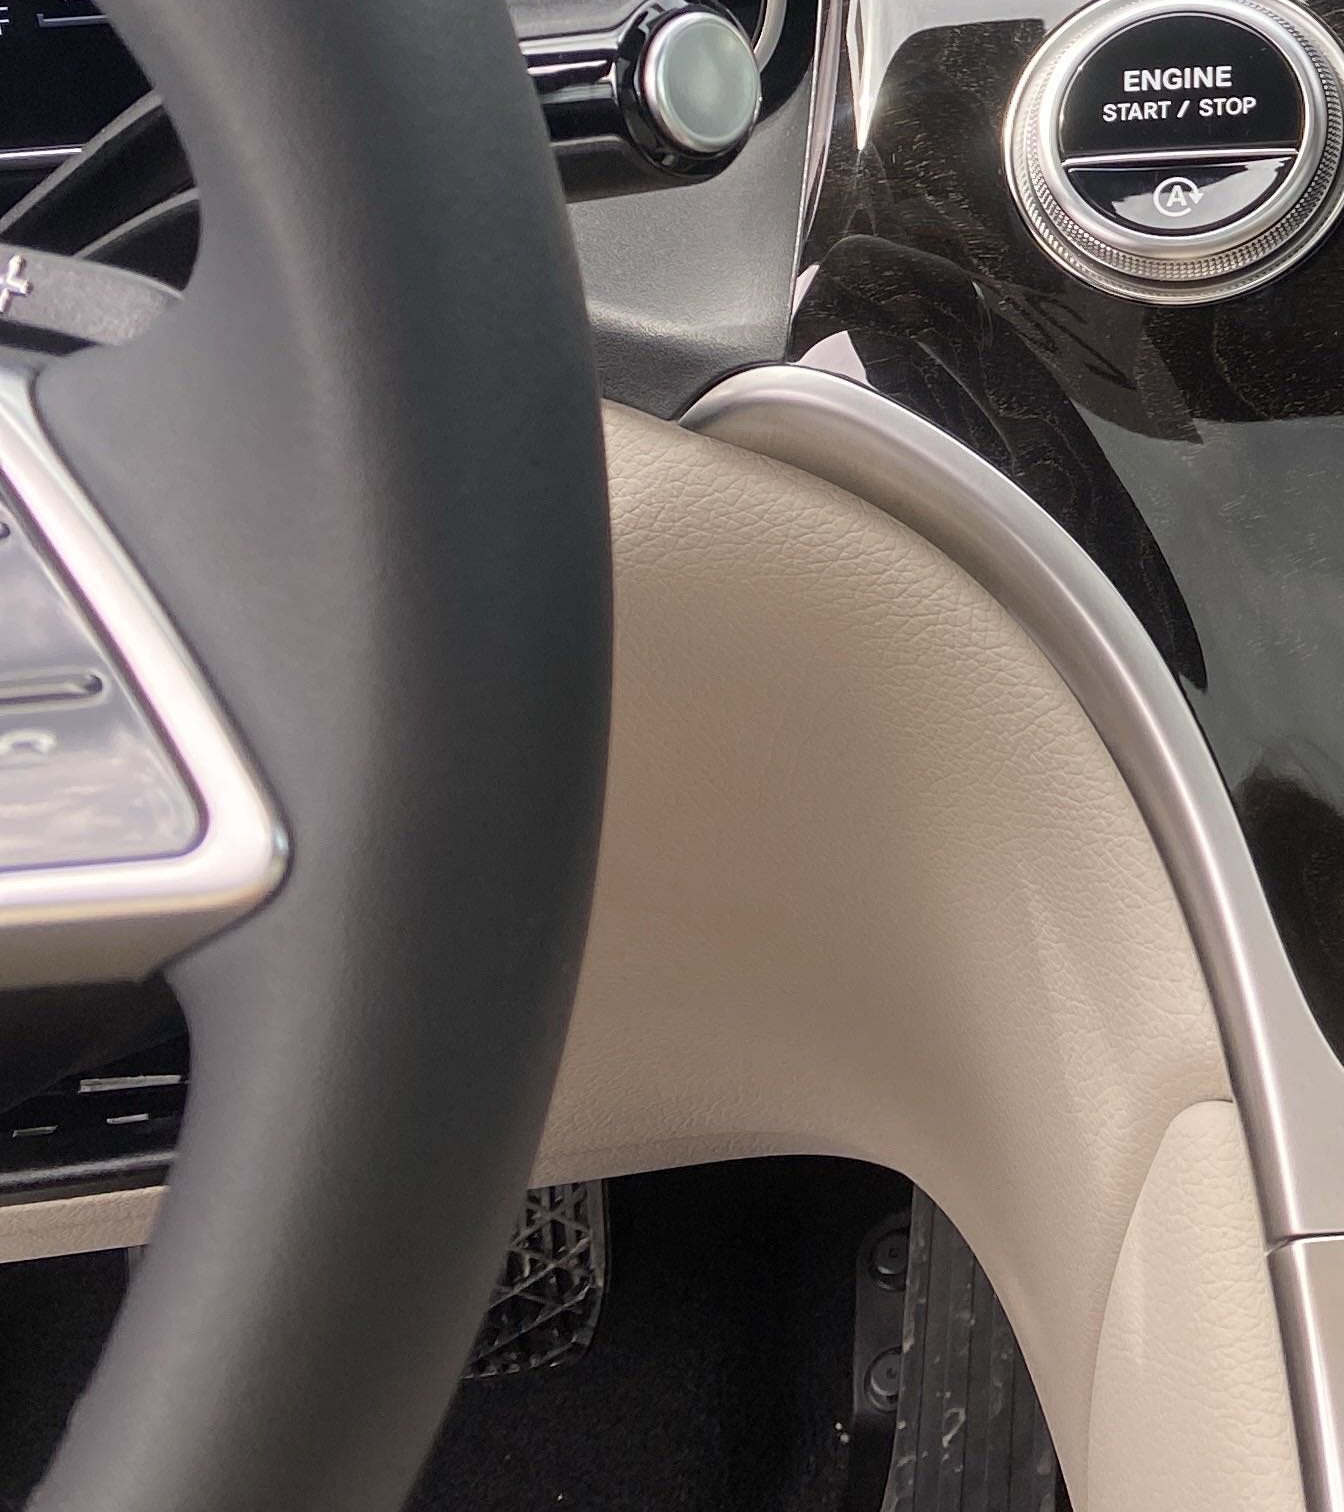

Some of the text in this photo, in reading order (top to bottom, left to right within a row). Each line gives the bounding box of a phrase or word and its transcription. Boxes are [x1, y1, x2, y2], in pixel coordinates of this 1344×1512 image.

[1123, 65, 1233, 92] ENGINE
[1102, 100, 1172, 122] START
[1198, 96, 1257, 117] STOP
